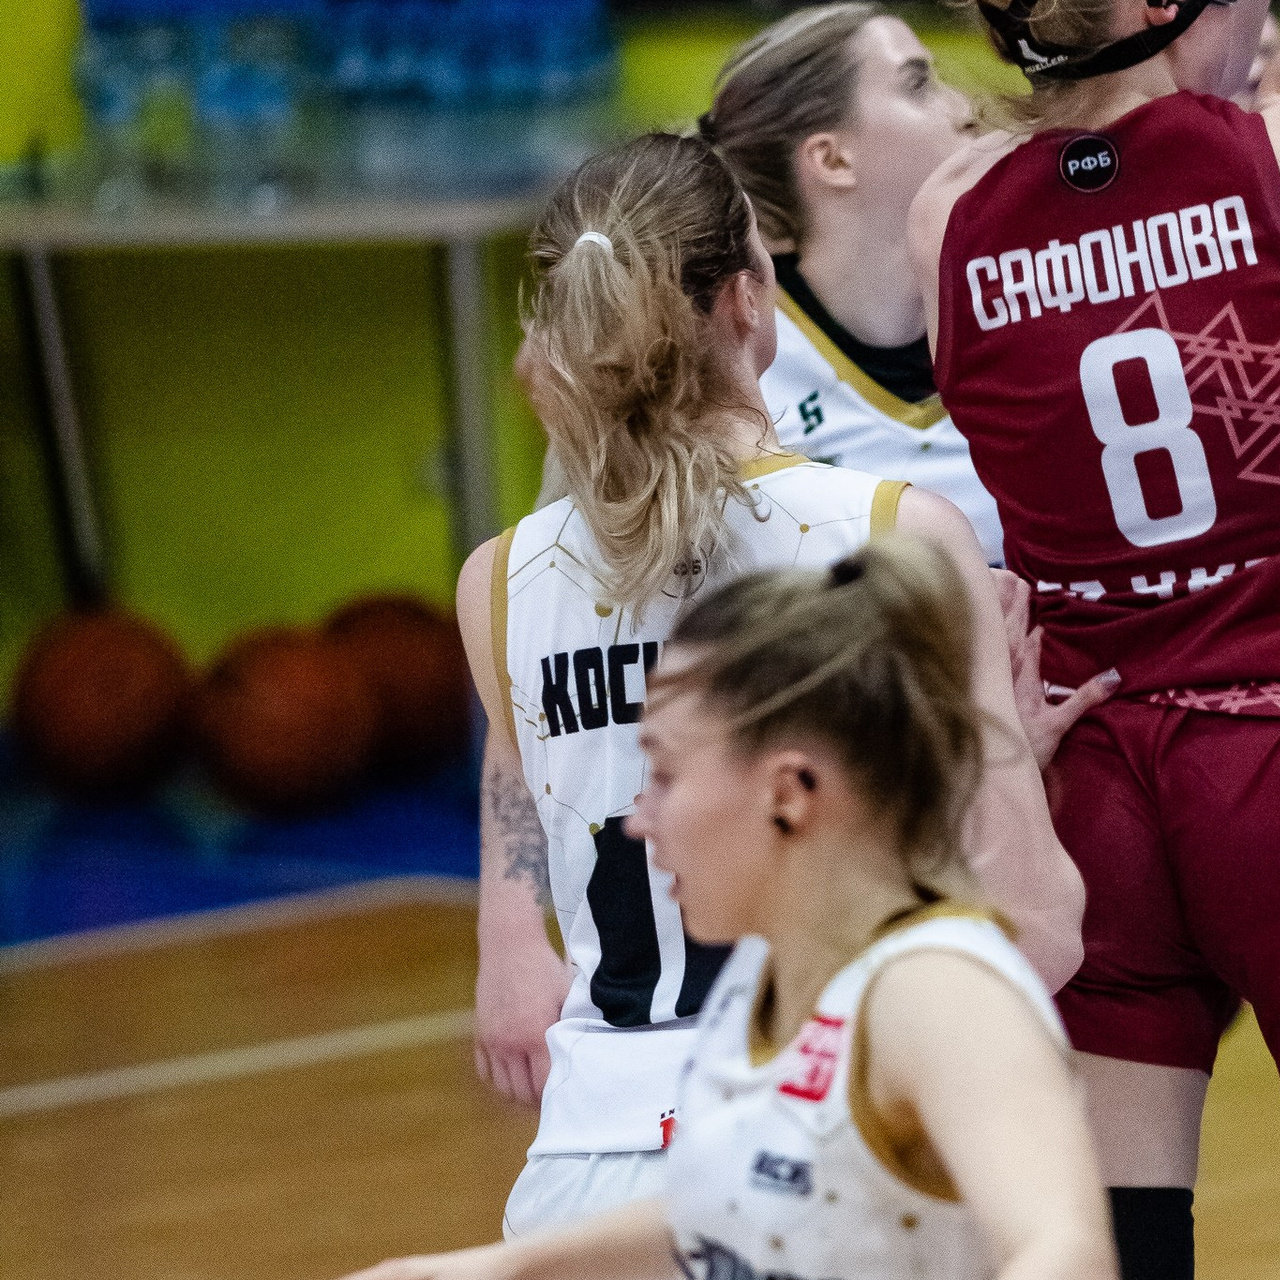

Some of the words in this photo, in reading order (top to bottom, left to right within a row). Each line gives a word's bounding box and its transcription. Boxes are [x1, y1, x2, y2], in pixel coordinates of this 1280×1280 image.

[1068, 150, 1111, 176] РФБ
[966, 195, 1258, 332] САФОНОВА
[1079, 327, 1217, 548] 8
